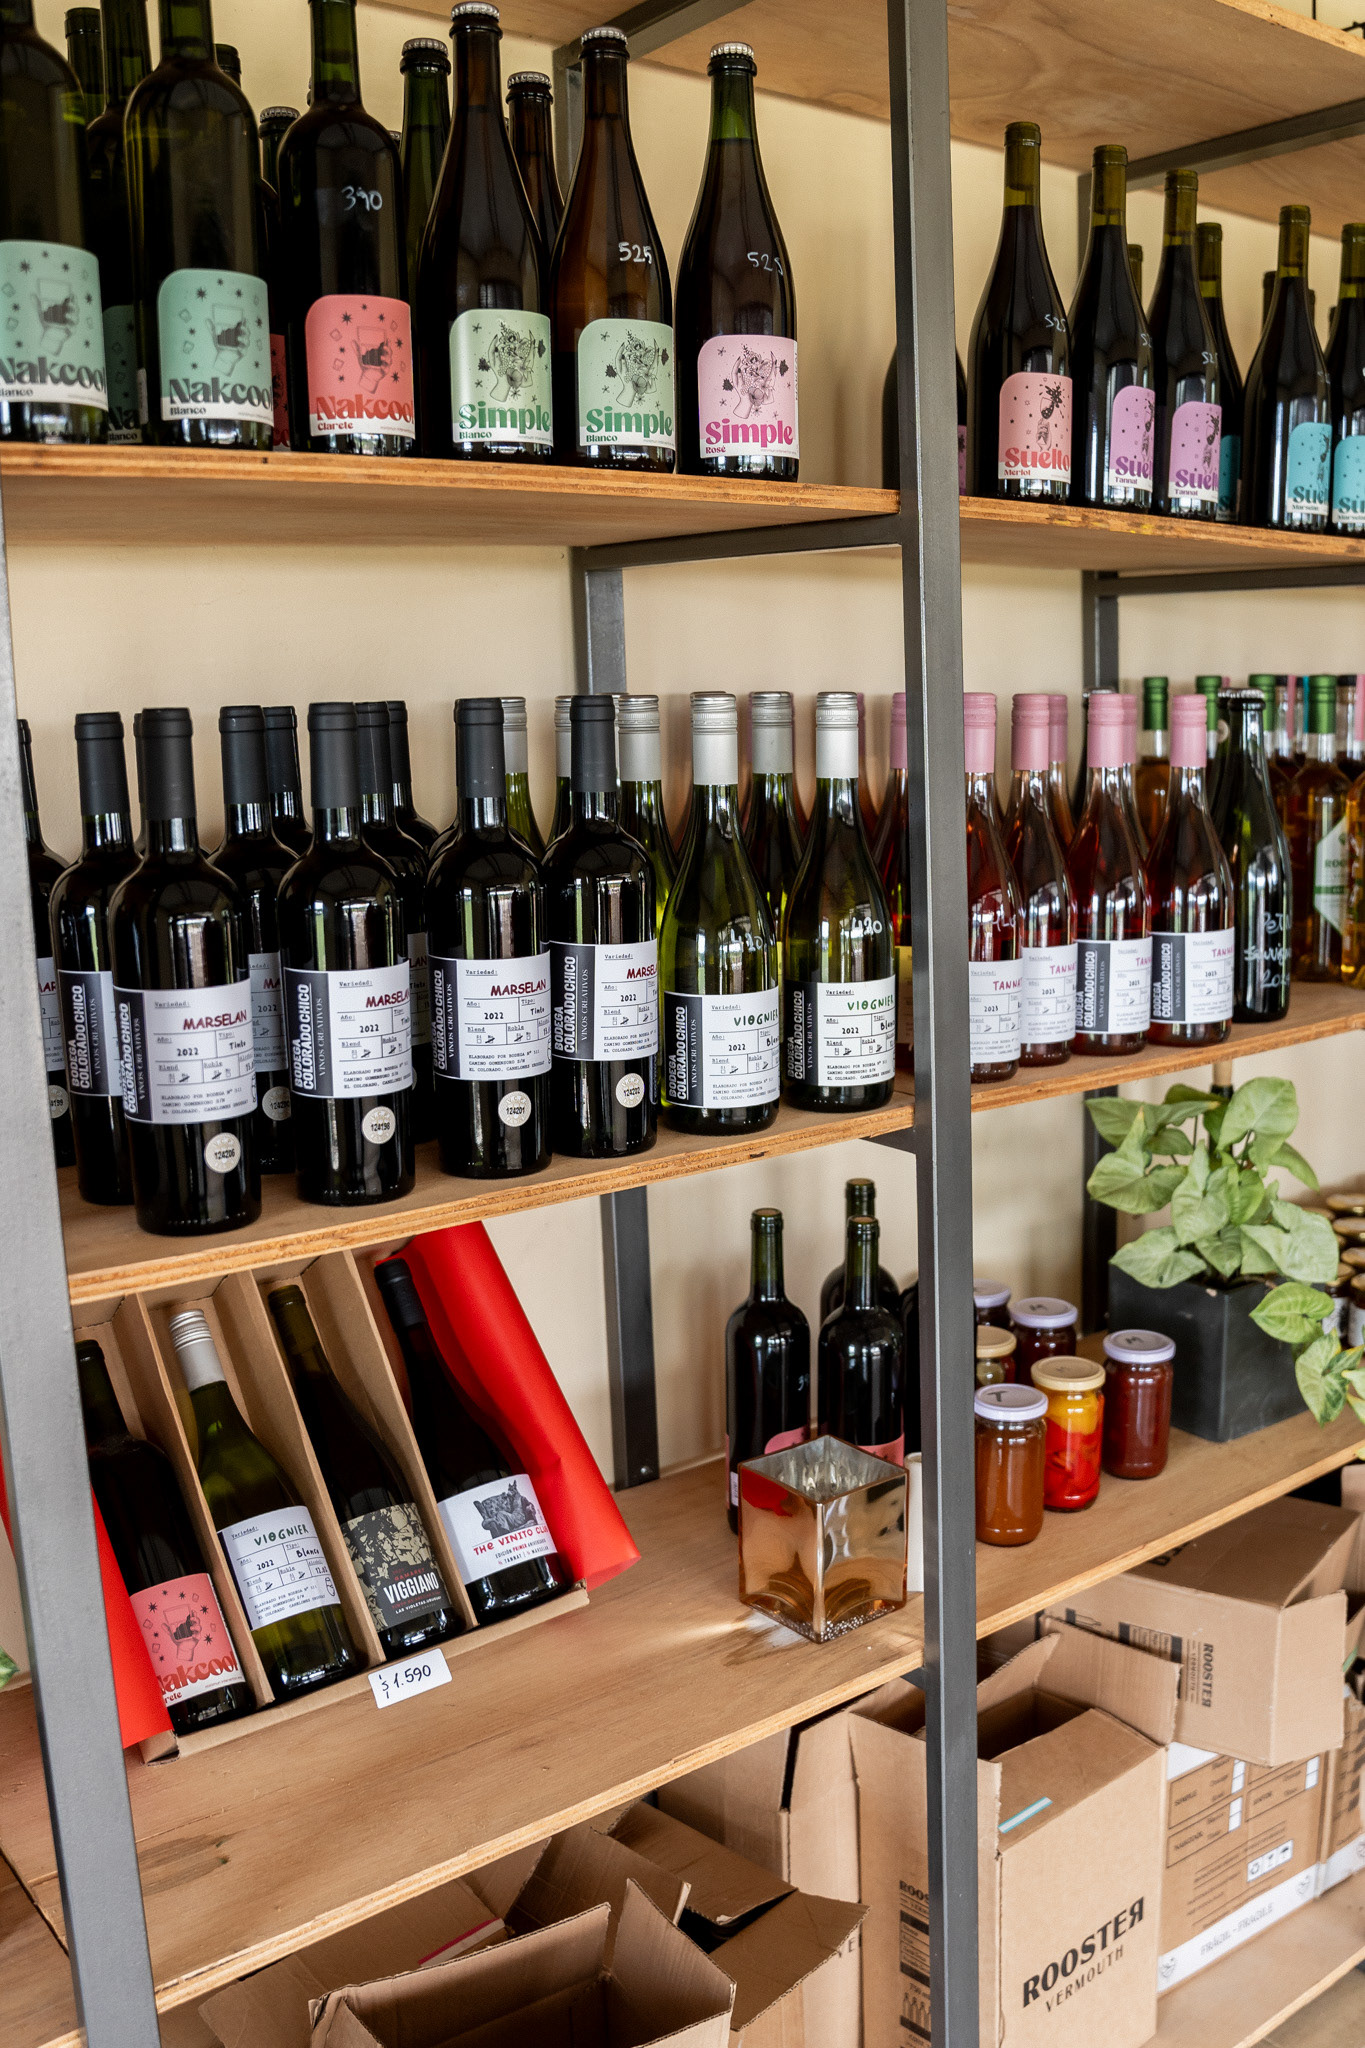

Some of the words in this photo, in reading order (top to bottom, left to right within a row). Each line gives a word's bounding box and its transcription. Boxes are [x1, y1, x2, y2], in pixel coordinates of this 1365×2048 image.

[341, 185, 383, 211] 390
[618, 241, 652, 264] 525
[170, 407, 206, 416] Blanco
[459, 401, 551, 434] Simple
[586, 406, 674, 438] Simple
[459, 431, 492, 439] Blanco
[586, 434, 618, 442] Blanco
[705, 418, 794, 448] Simple
[705, 445, 726, 454] Rosé
[1004, 446, 1071, 472] Suelto
[1004, 469, 1031, 477] Merlot
[1115, 476, 1138, 485] Tannat
[1175, 488, 1199, 496] Tannat
[1085, 951, 1095, 979] CHICO
[1161, 943, 1171, 971] CHICO
[490, 978, 547, 997] MARSELAN
[564, 956, 576, 992] CHICO
[433, 970, 442, 1007] CHICO
[620, 993, 637, 1002] 2022
[1152, 981, 1161, 1017] BODEGA
[1161, 970, 1171, 1018] COLORADO
[72, 985, 84, 1023] CHICO
[258, 1004, 278, 1012] 2022
[297, 984, 311, 1023] CHICO
[484, 1012, 504, 1020] 2022
[530, 1007, 545, 1015] Tinto
[793, 990, 803, 1023] CHICO
[1083, 980, 1095, 1028] COLORADO
[119, 1003, 131, 1044] CHICO
[183, 1009, 247, 1031] MARSELAN
[360, 1024, 379, 1033] 2022
[554, 1006, 564, 1051] BODEGA
[564, 992, 576, 1053] COLORADO
[675, 1006, 686, 1041] CHICO
[177, 1047, 199, 1056] 2022
[435, 1008, 445, 1070] COLORADO
[728, 1043, 746, 1051] 2022
[793, 1024, 803, 1080] COLORADO
[68, 1039, 79, 1087] BODEGA
[75, 1024, 90, 1089] COLORADO
[292, 1039, 303, 1088] BODEGA
[300, 1024, 314, 1090] COLORADO
[676, 1041, 686, 1100] COLORADO
[122, 1045, 136, 1113] COLORADO
[254, 1524, 309, 1546] VIOGNIER
[498, 1529, 534, 1546] VINITO
[512, 1543, 528, 1552] PRIMER
[257, 1559, 274, 1570] 2022
[296, 1548, 319, 1558] Blanco
[383, 1571, 440, 1604] VIGGIANO
[393, 1664, 431, 1688] 1.590
[1022, 1896, 1144, 2009] ROOSTER
[1045, 1944, 1124, 2013] VERMOUTH
